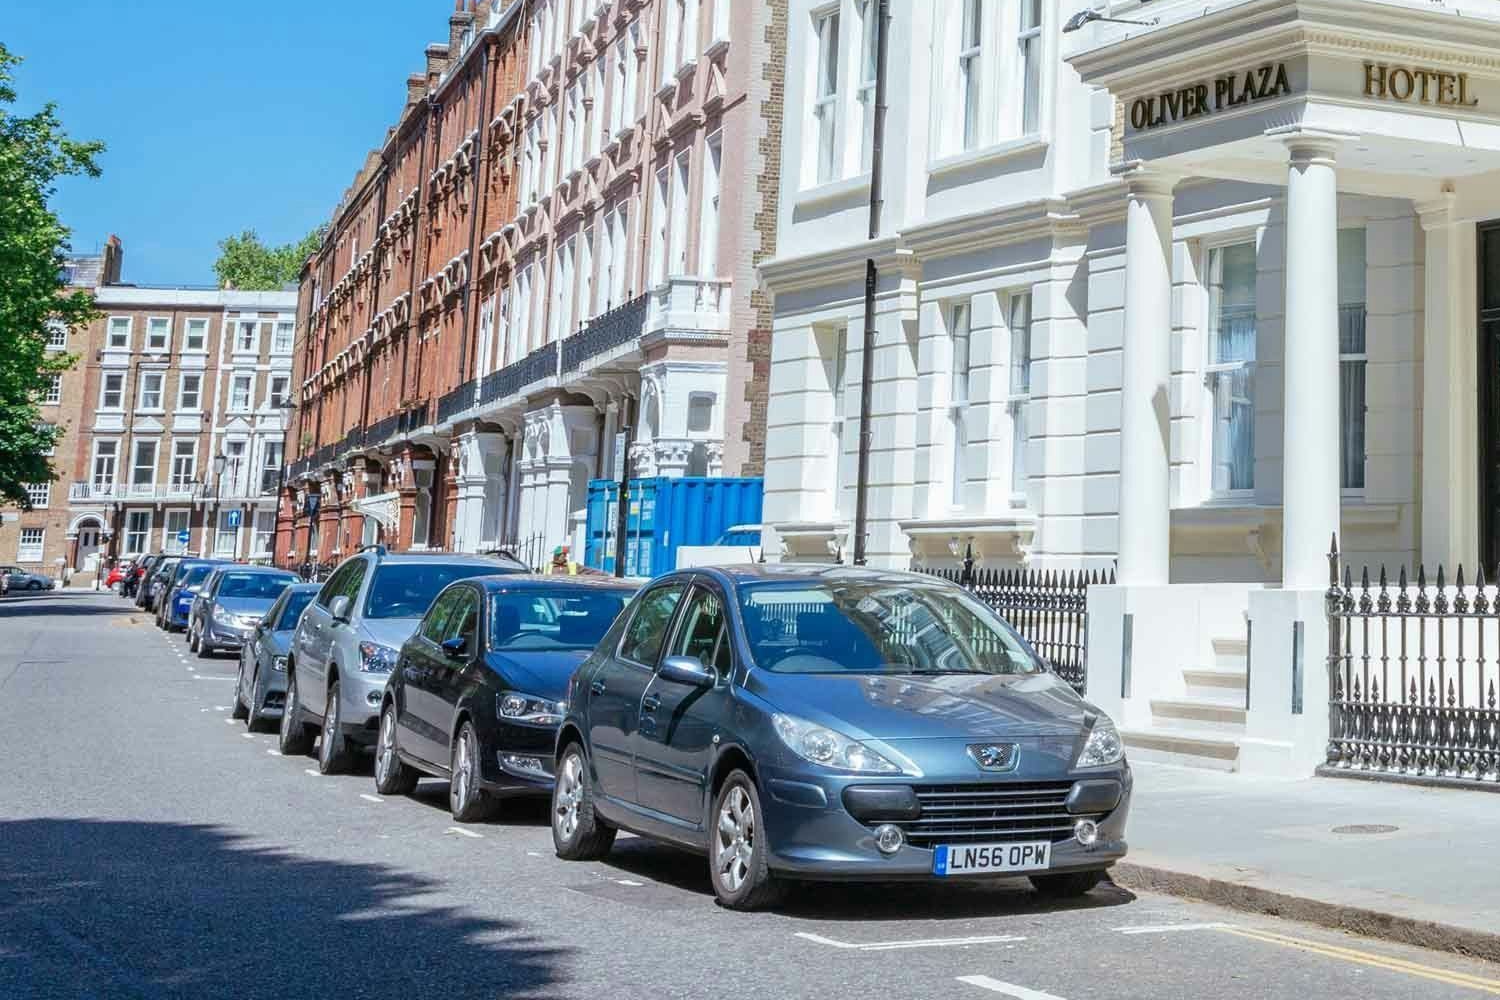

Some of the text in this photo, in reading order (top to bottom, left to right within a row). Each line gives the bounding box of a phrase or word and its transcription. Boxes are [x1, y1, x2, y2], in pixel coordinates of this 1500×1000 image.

[1130, 62, 1291, 130] OLIVER PLAZA
[1362, 63, 1479, 106] HOTEL
[950, 844, 1047, 869] LN56 OPW
